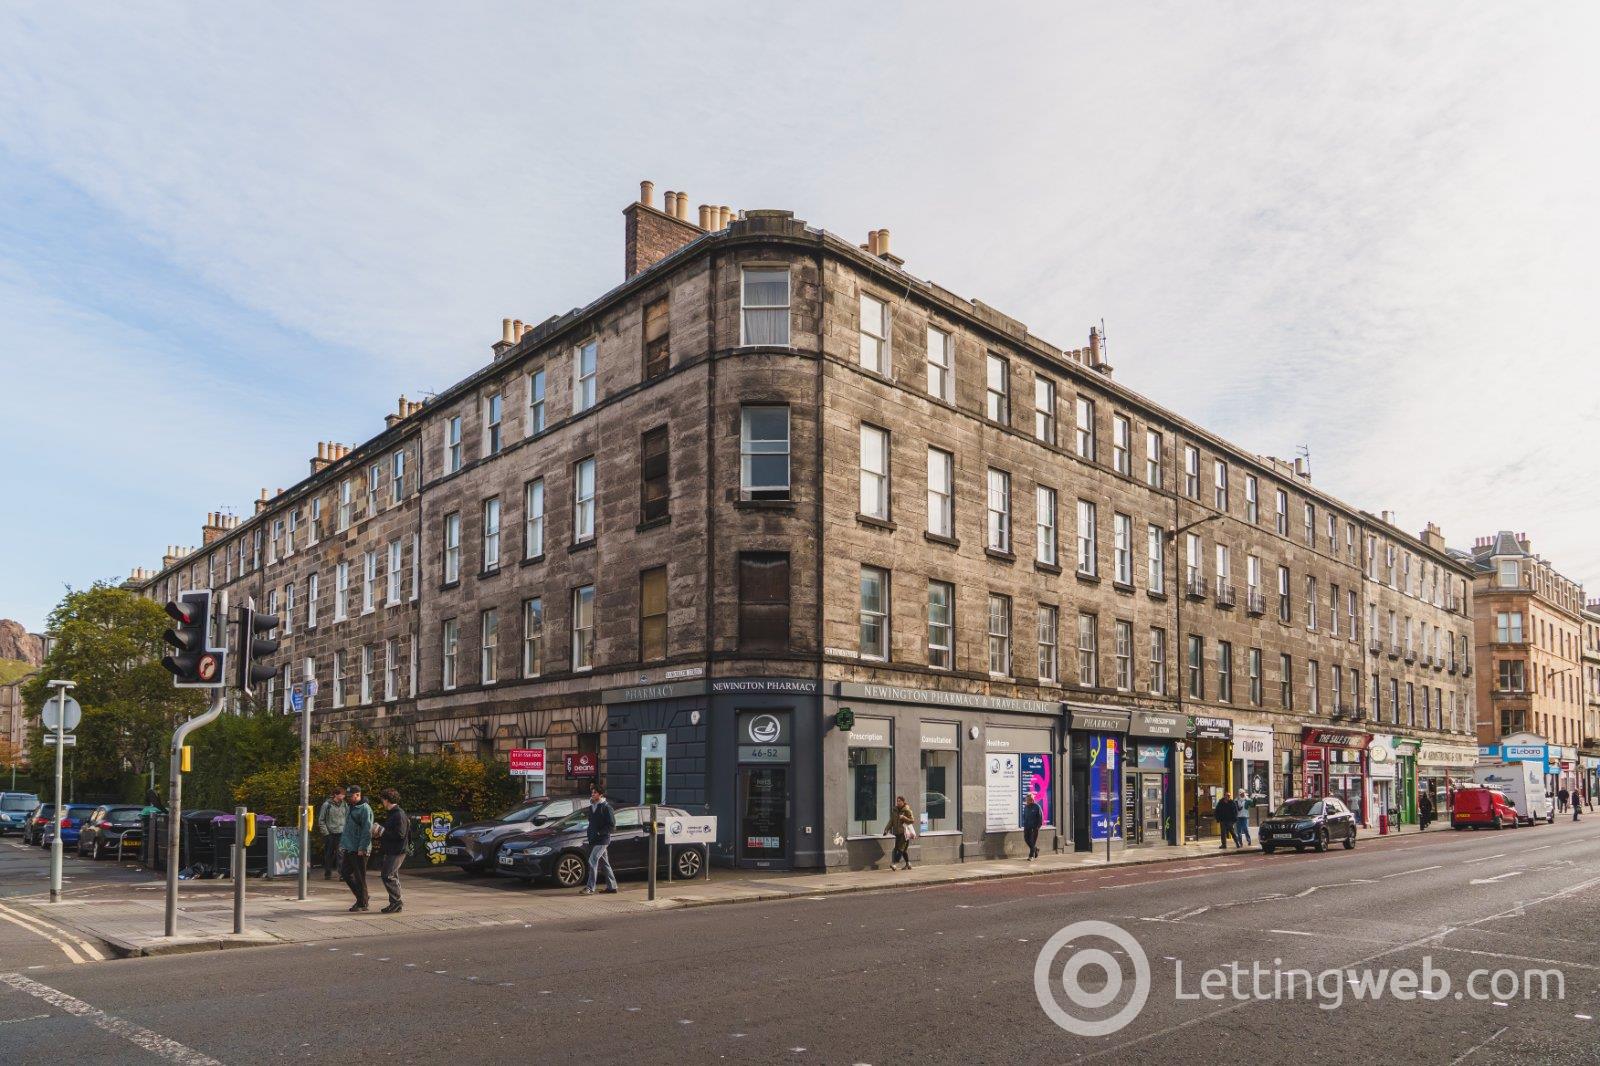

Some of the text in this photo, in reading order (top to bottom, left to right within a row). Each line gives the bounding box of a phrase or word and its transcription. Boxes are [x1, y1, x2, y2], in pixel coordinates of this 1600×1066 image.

[713, 682, 816, 691] NEWINGTON PHARMACY
[625, 684, 674, 700] PHARMACY
[864, 686, 928, 700] NEWINGTON
[931, 692, 980, 705] PHARMACY
[991, 698, 1020, 709] TRAVEL
[1023, 701, 1049, 712] CLINIC
[1083, 718, 1120, 729] PHARMACY
[849, 732, 883, 741] Prescription
[921, 735, 952, 744] Consultation
[752, 749, 778, 757] 46-52
